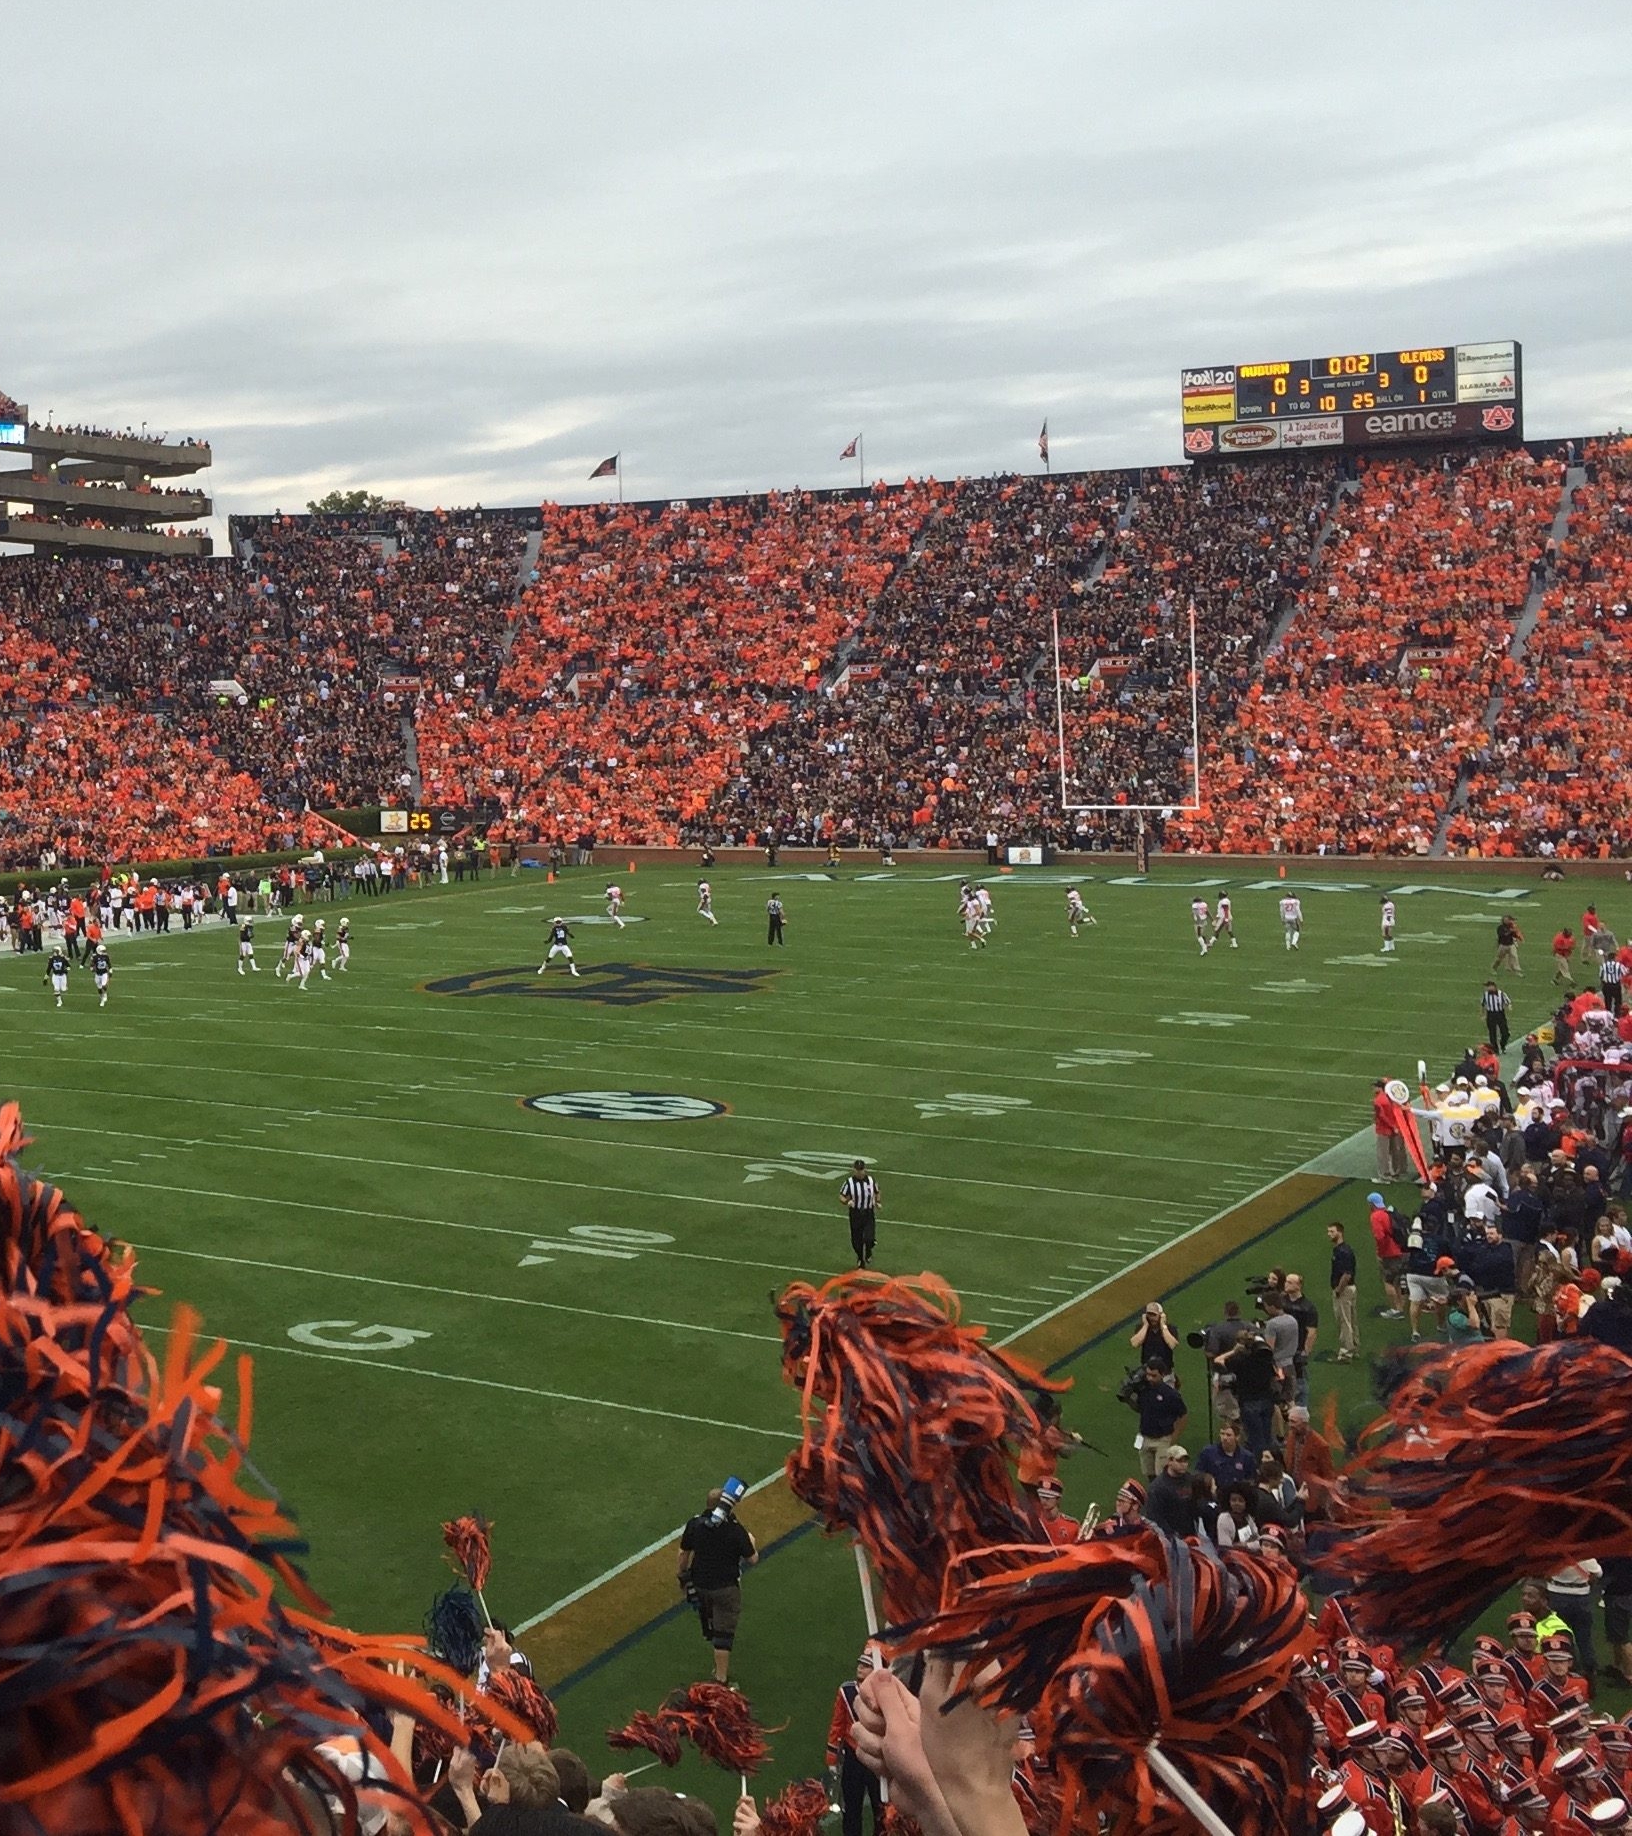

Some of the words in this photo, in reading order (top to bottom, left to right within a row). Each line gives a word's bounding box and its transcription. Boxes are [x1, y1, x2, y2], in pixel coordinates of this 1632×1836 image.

[1215, 370, 1234, 384] 20
[1240, 363, 1290, 377] AUBURN
[1415, 365, 1427, 383] 0
[1274, 377, 1287, 395] 0
[1300, 379, 1310, 394] 3
[1379, 372, 1390, 388] 3
[1320, 396, 1336, 411] 10
[1352, 393, 1374, 408] 25
[1420, 389, 1425, 403] 1
[1240, 405, 1262, 415] DOWN
[1271, 401, 1276, 414] 1
[1288, 402, 1299, 410] TO
[1365, 411, 1439, 434] eamc
[1225, 430, 1273, 439] CAROLINA
[410, 813, 432, 829] 25
[738, 872, 1535, 899] AUBURN
[744, 1149, 878, 1181] 20
[530, 1224, 676, 1259] 10
[287, 1319, 434, 1351] G
